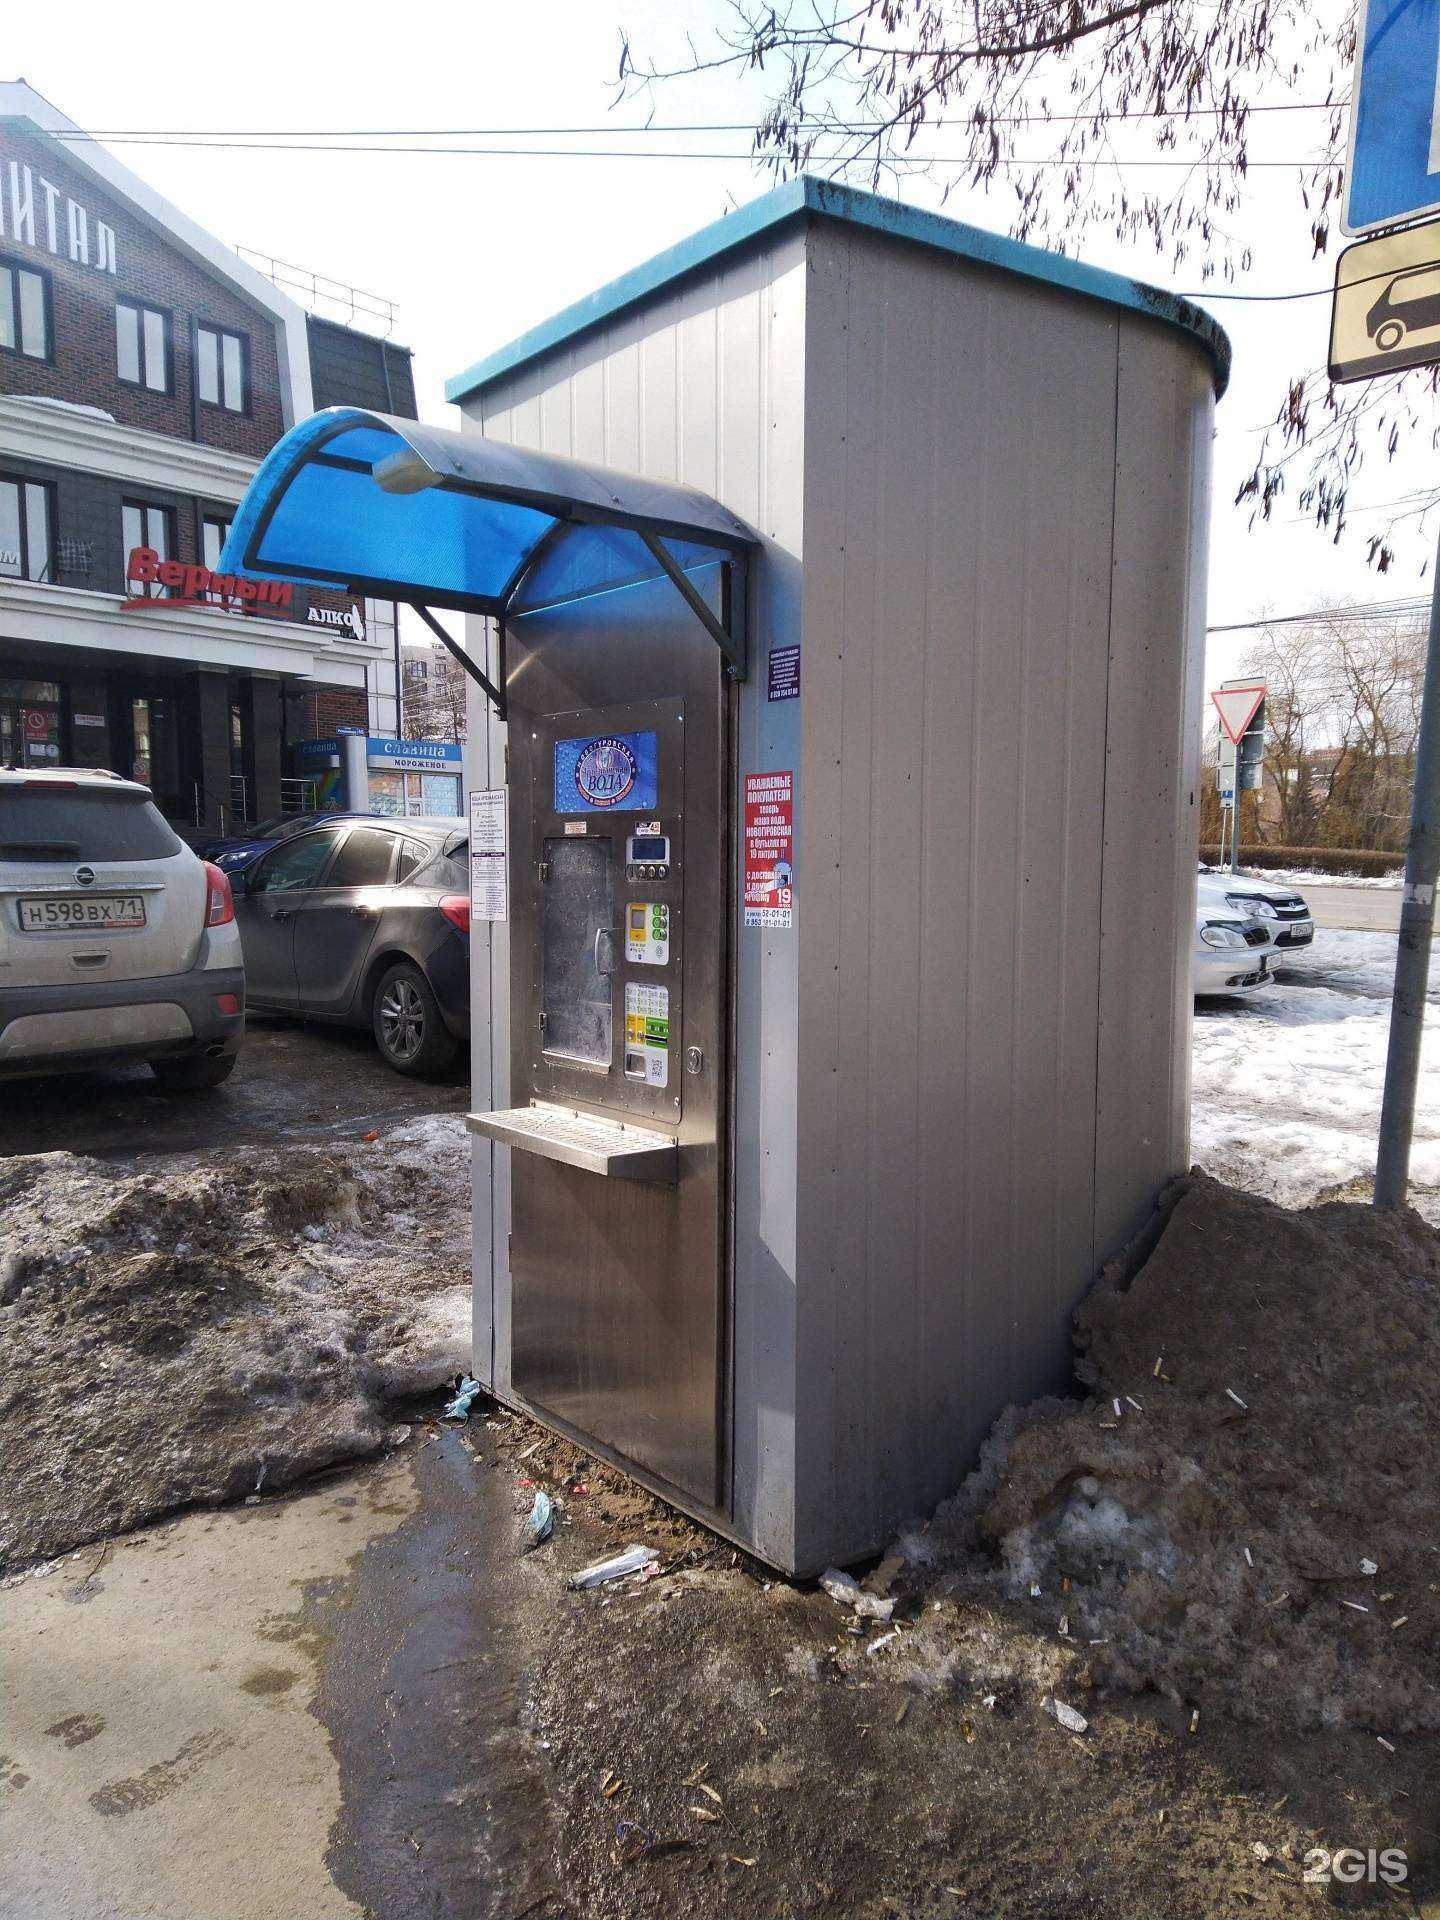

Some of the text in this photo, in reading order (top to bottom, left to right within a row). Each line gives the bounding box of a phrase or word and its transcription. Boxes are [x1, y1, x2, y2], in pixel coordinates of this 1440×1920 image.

[0, 161, 117, 275] ИТАЛ
[307, 607, 355, 627] АЛКО
[577, 739, 634, 768] НОВОГУРОВСКАЯ
[394, 759, 447, 769] МОРОЖЕНОЕ
[588, 774, 623, 791] ВОДА
[747, 775, 791, 791] УВАЖАЕМЫЕ
[747, 789, 791, 804] ПОКУПАТЕЛИ
[777, 888, 791, 904] 19
[29, 900, 137, 922] Н598ВХ 71
